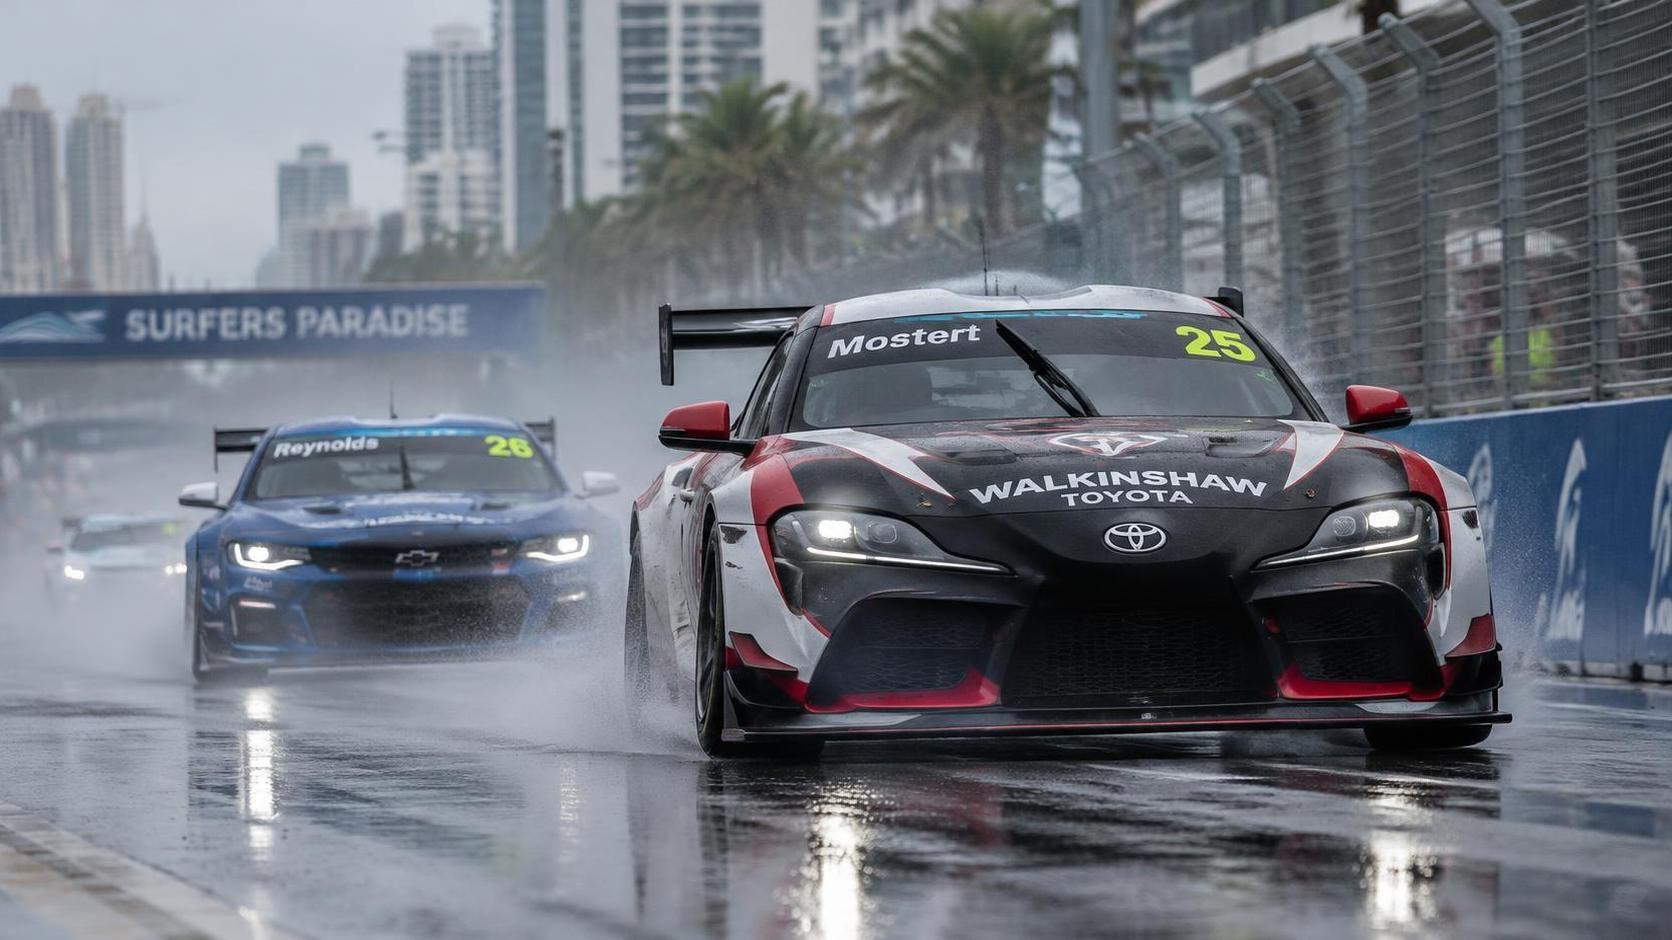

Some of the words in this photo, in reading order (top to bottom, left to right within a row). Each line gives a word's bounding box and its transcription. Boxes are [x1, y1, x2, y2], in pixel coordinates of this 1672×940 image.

[126, 308, 287, 341] SURFERS
[297, 305, 469, 338] PARADISE
[827, 325, 981, 359] Mostert
[1175, 326, 1256, 361] 25
[274, 437, 379, 458] Reynolds
[485, 436, 534, 458] 26
[969, 471, 1268, 504] WALKINSHAW
[1061, 490, 1193, 506] TOYOTA
